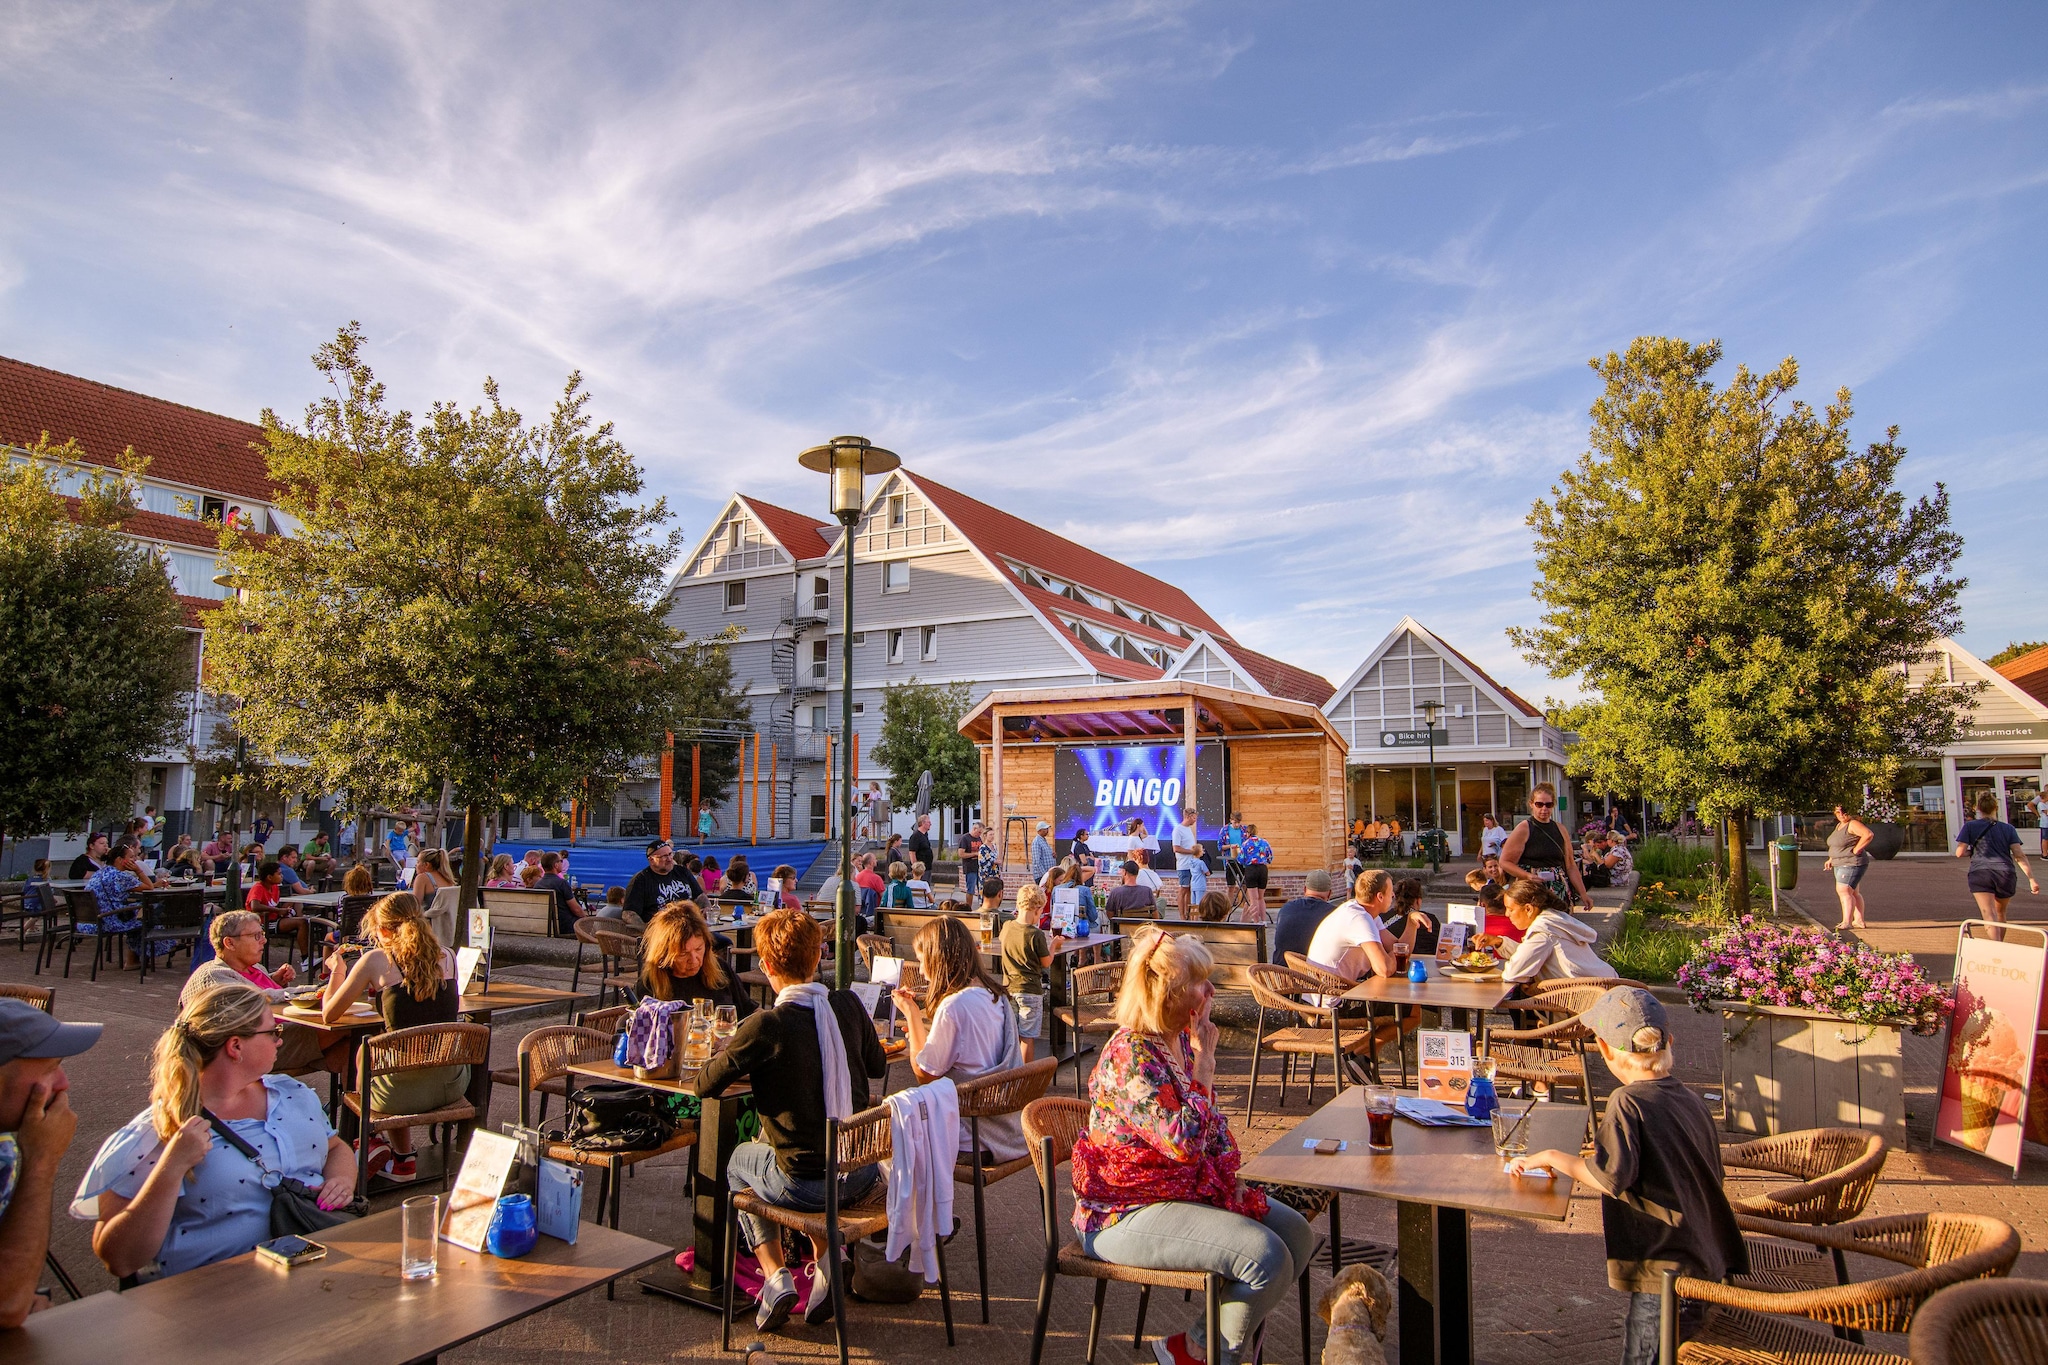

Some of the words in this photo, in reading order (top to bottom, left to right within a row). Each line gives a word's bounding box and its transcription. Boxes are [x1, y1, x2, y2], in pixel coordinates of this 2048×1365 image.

[1968, 728, 2032, 737] Supermarket
[1095, 777, 1181, 807] BINGO
[1966, 960, 1999, 976] CARTE
[2001, 967, 2030, 984] D'OR
[1450, 1055, 1465, 1066] 315
